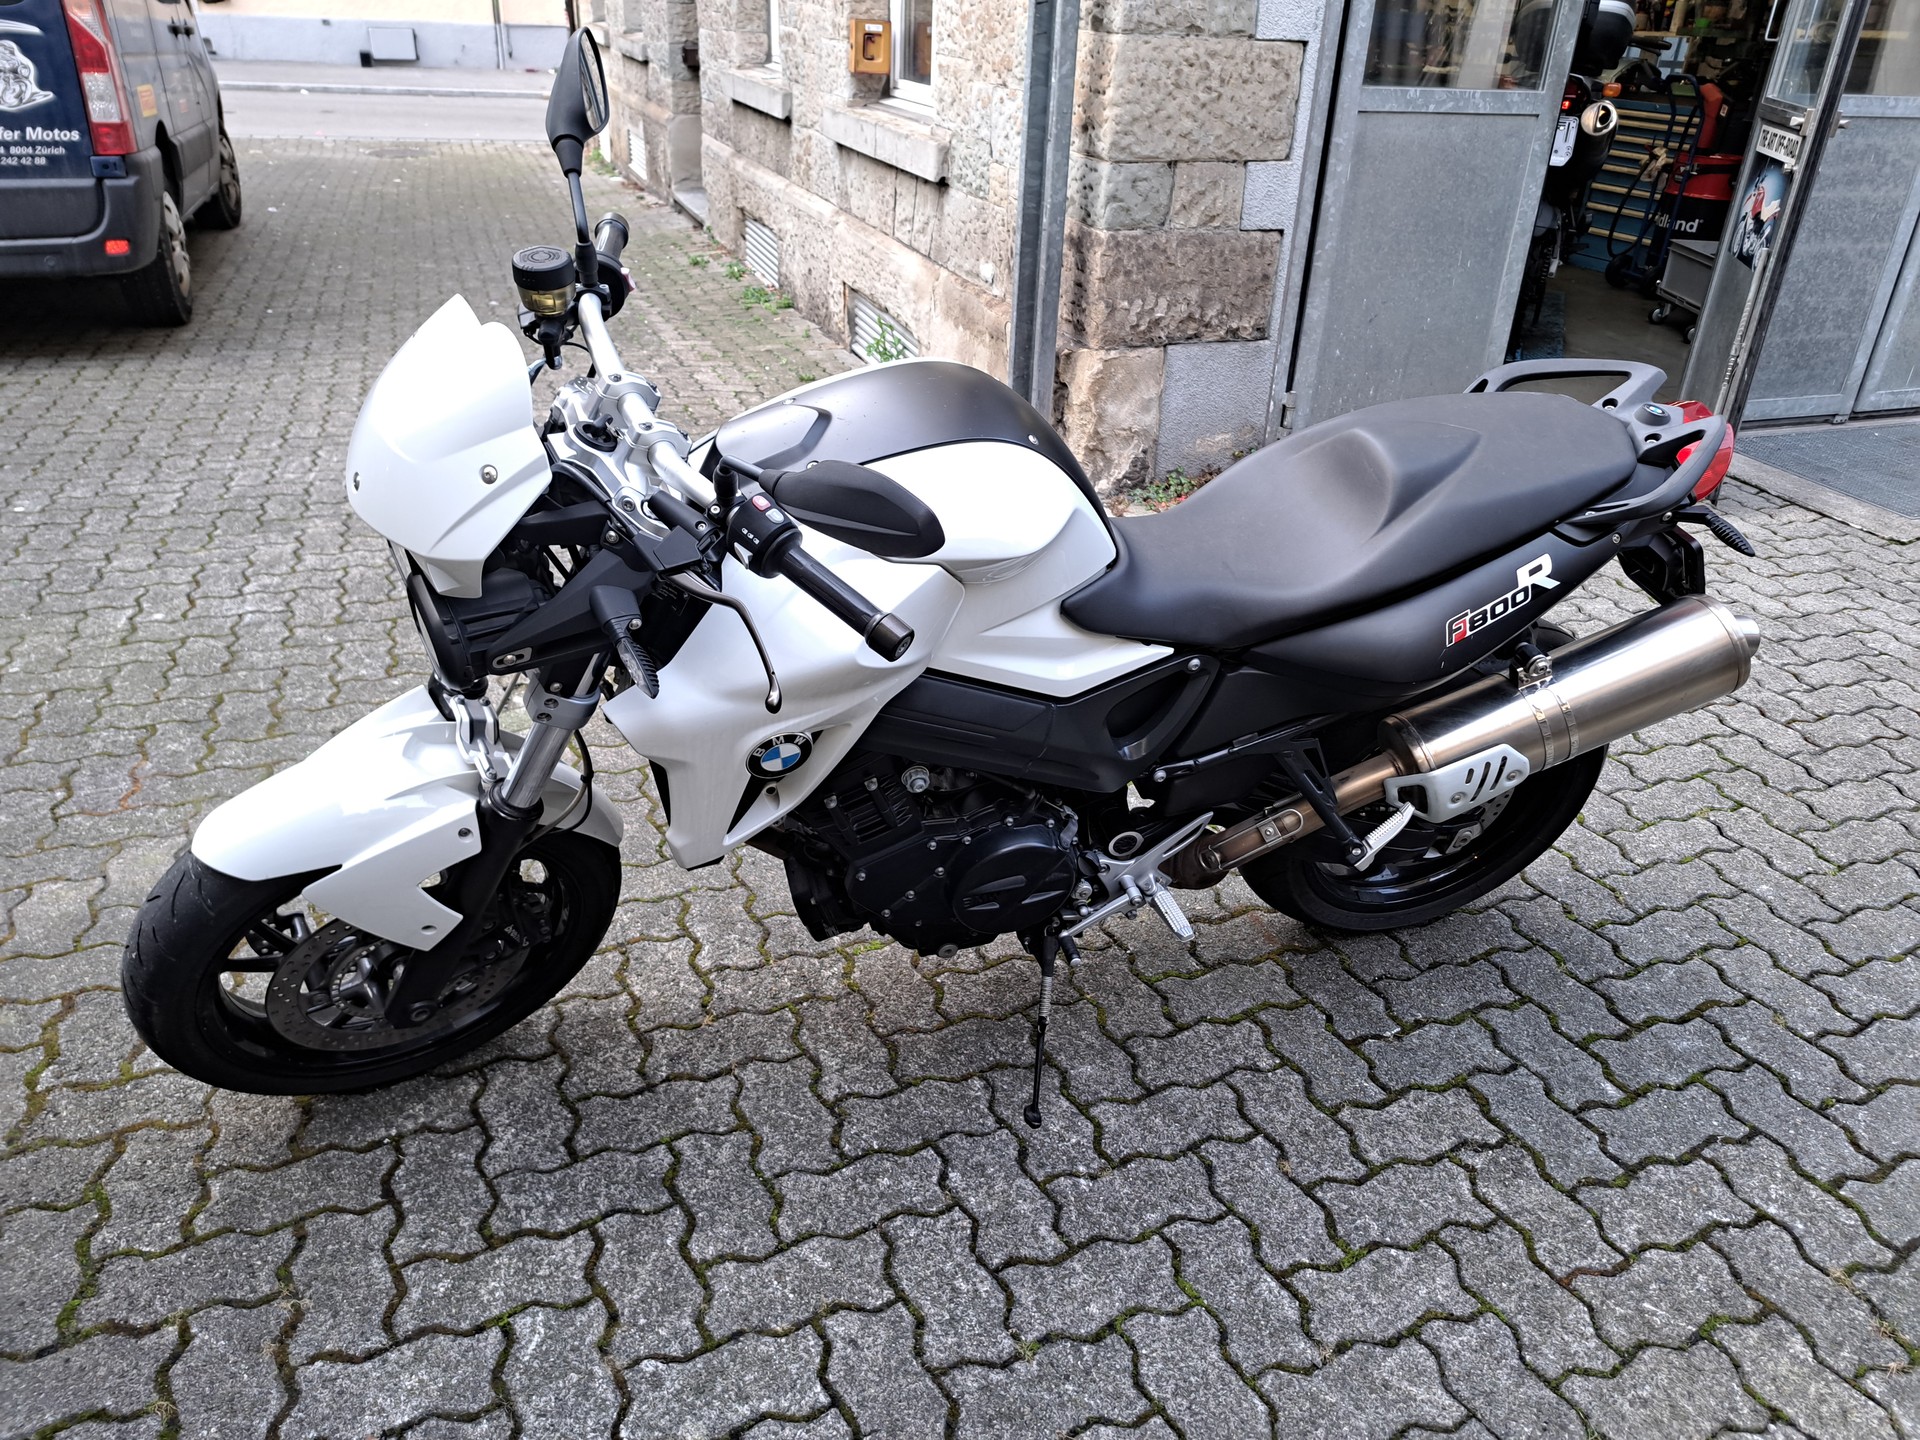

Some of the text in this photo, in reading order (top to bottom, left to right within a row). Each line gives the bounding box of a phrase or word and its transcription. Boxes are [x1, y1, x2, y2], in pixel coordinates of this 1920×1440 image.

[26, 126, 80, 141] Motos
[9, 145, 33, 155] 8004
[35, 145, 66, 155] Zürich
[0, 156, 47, 166] 242 42 88
[1446, 553, 1561, 647] F800R
[753, 735, 806, 757] BMW
